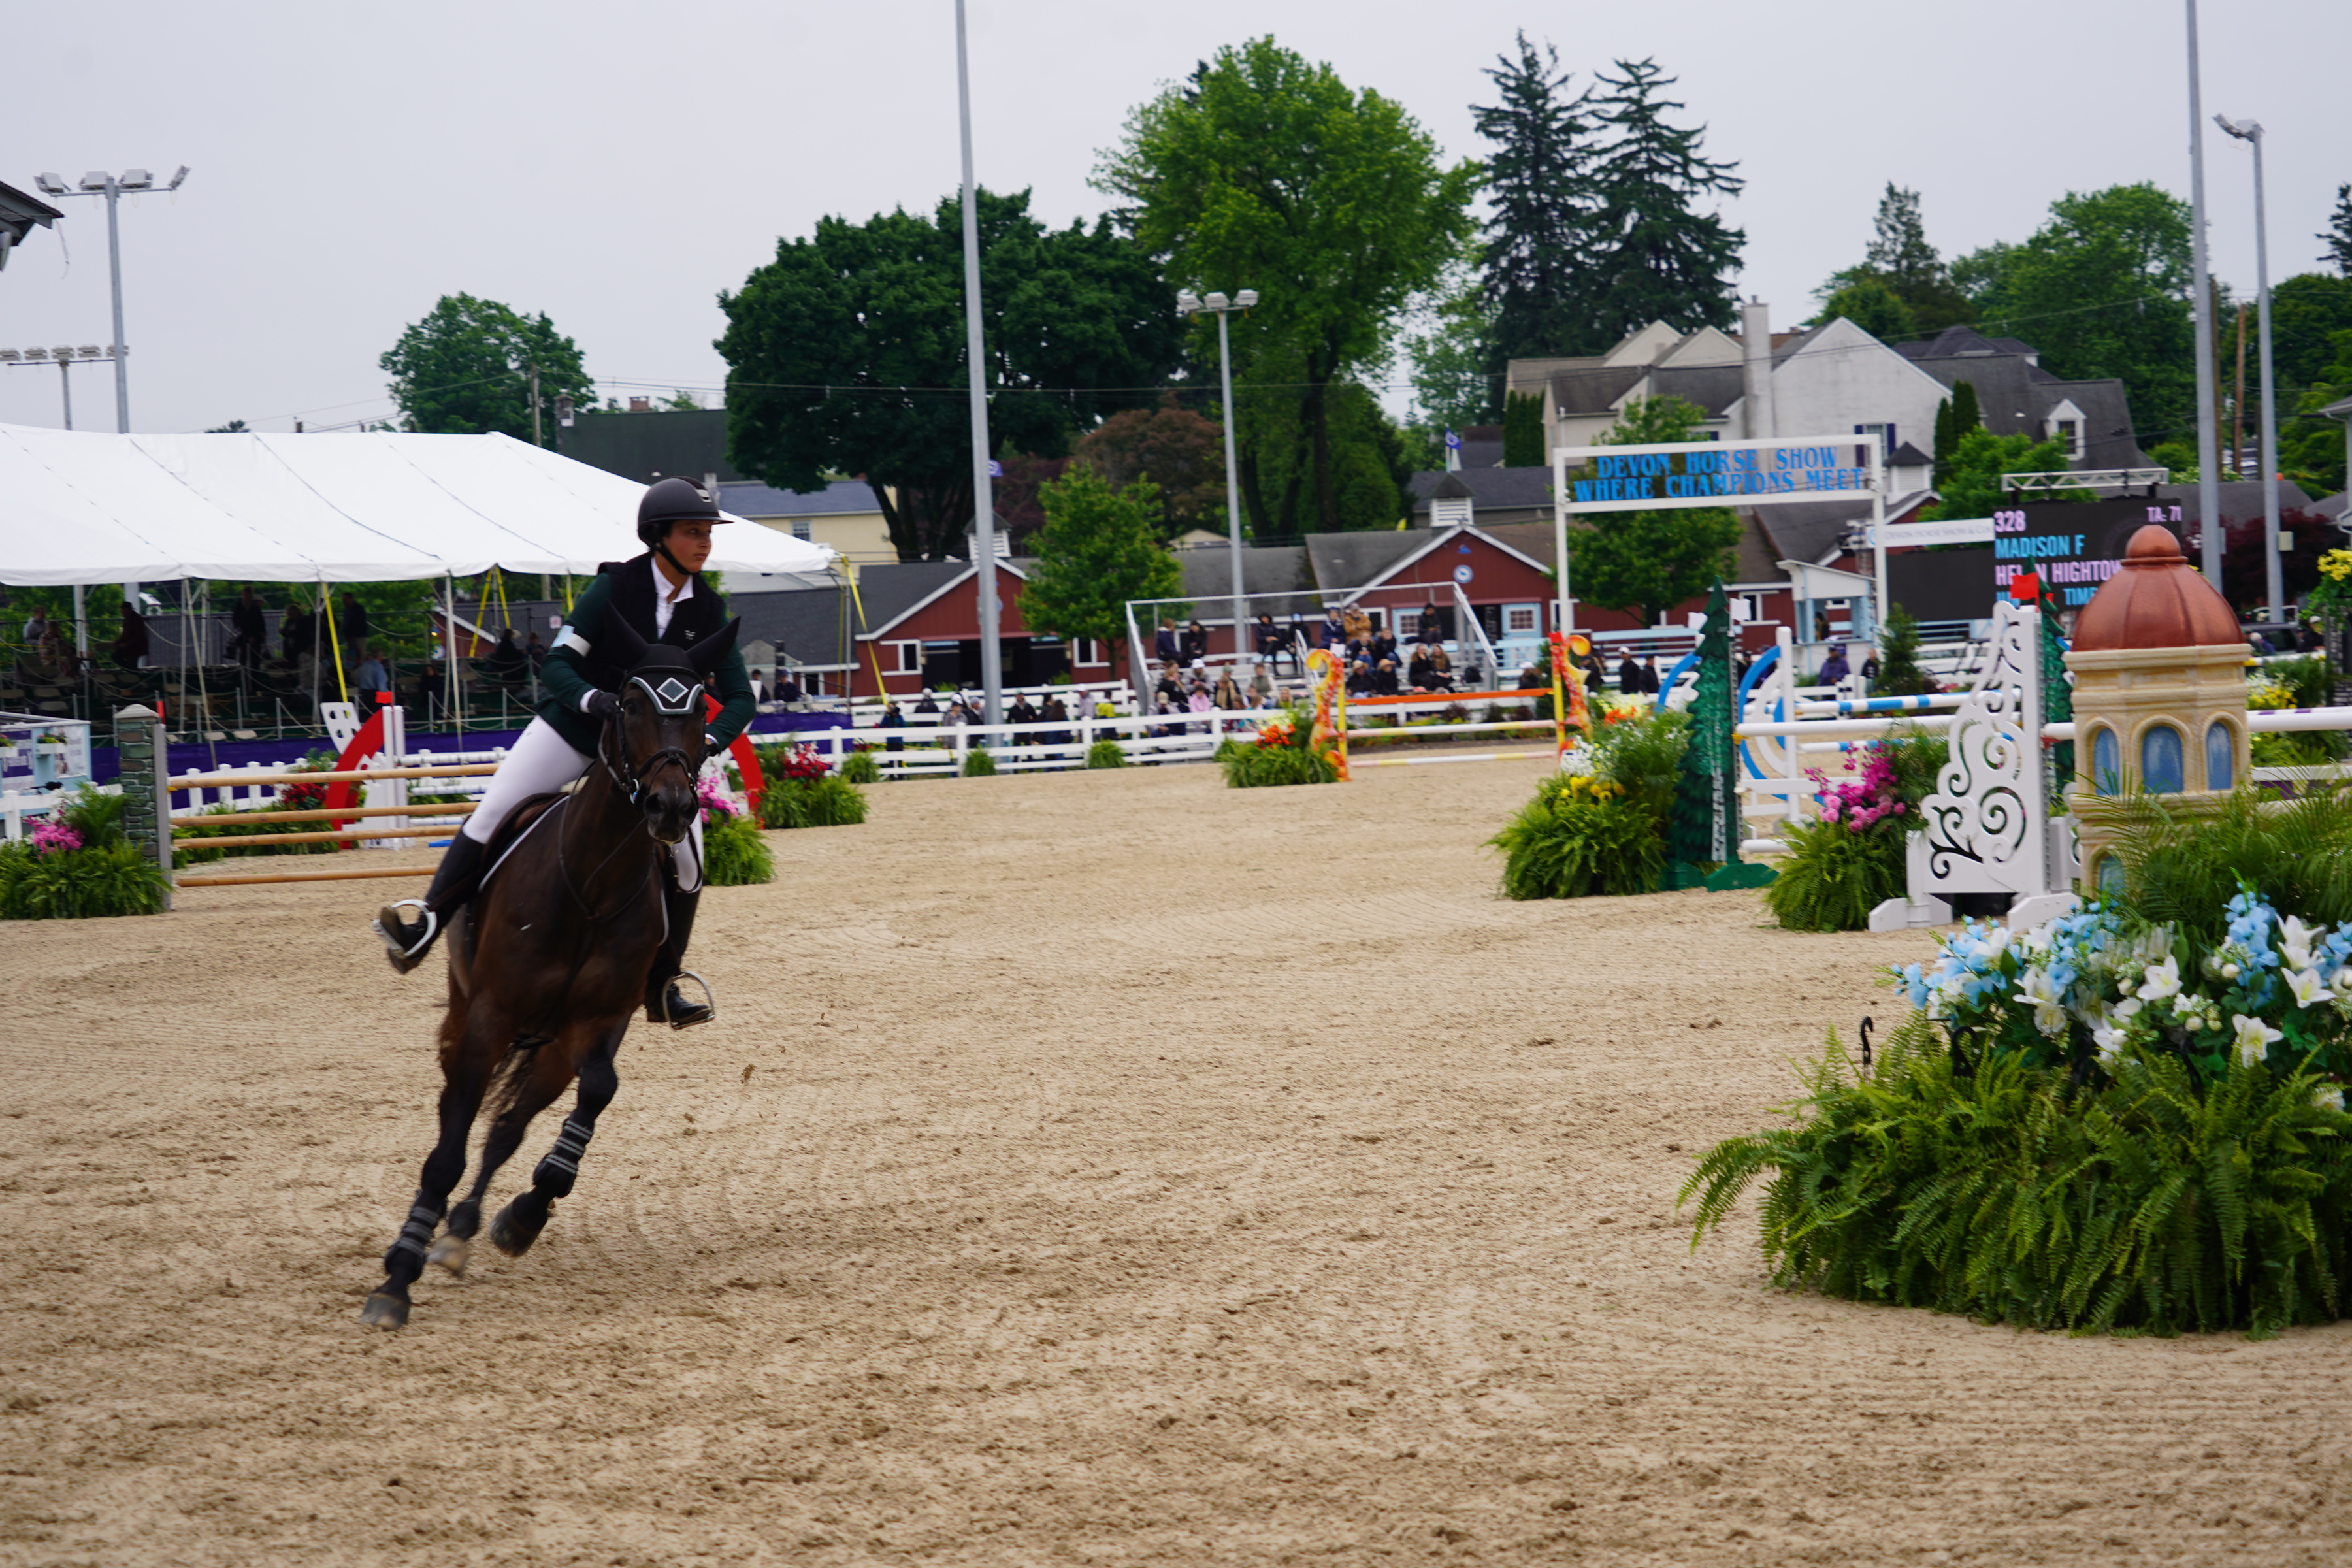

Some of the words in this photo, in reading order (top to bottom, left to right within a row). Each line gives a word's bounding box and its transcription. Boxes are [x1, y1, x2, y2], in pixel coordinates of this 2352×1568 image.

[1597, 453, 1671, 479] DEVON
[1685, 449, 1759, 475] HORSE
[1776, 446, 1838, 470] SHOW
[1573, 477, 1654, 502] WHERE
[1665, 471, 1794, 498] CHAMPIONS
[1805, 468, 1864, 491] MEET
[1994, 510, 2026, 532] 328
[1995, 534, 2070, 559] MADISON
[2074, 534, 2085, 555] F
